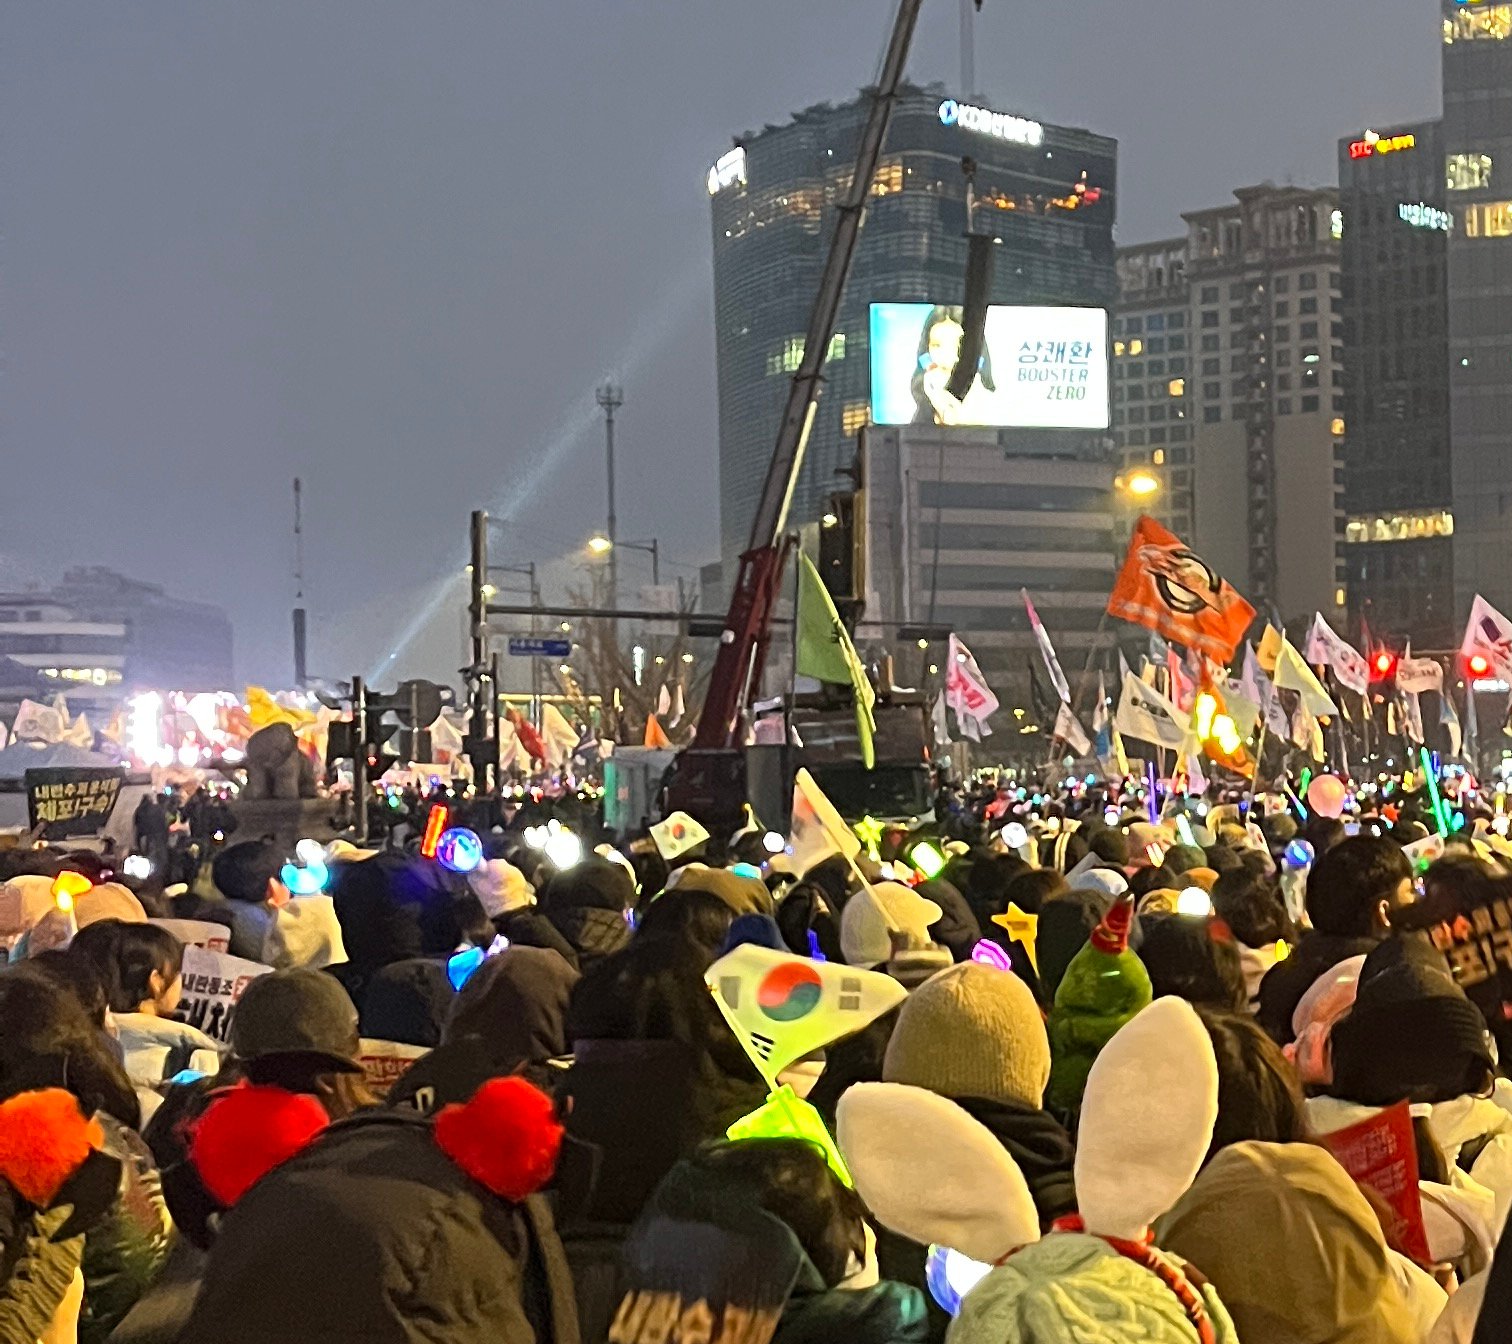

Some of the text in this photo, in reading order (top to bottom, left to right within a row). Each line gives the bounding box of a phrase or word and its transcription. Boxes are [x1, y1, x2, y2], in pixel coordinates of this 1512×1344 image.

[1018, 340, 1093, 366] 상쾌환
[1017, 367, 1089, 383] BOOSTER
[1046, 385, 1086, 400] ZERO
